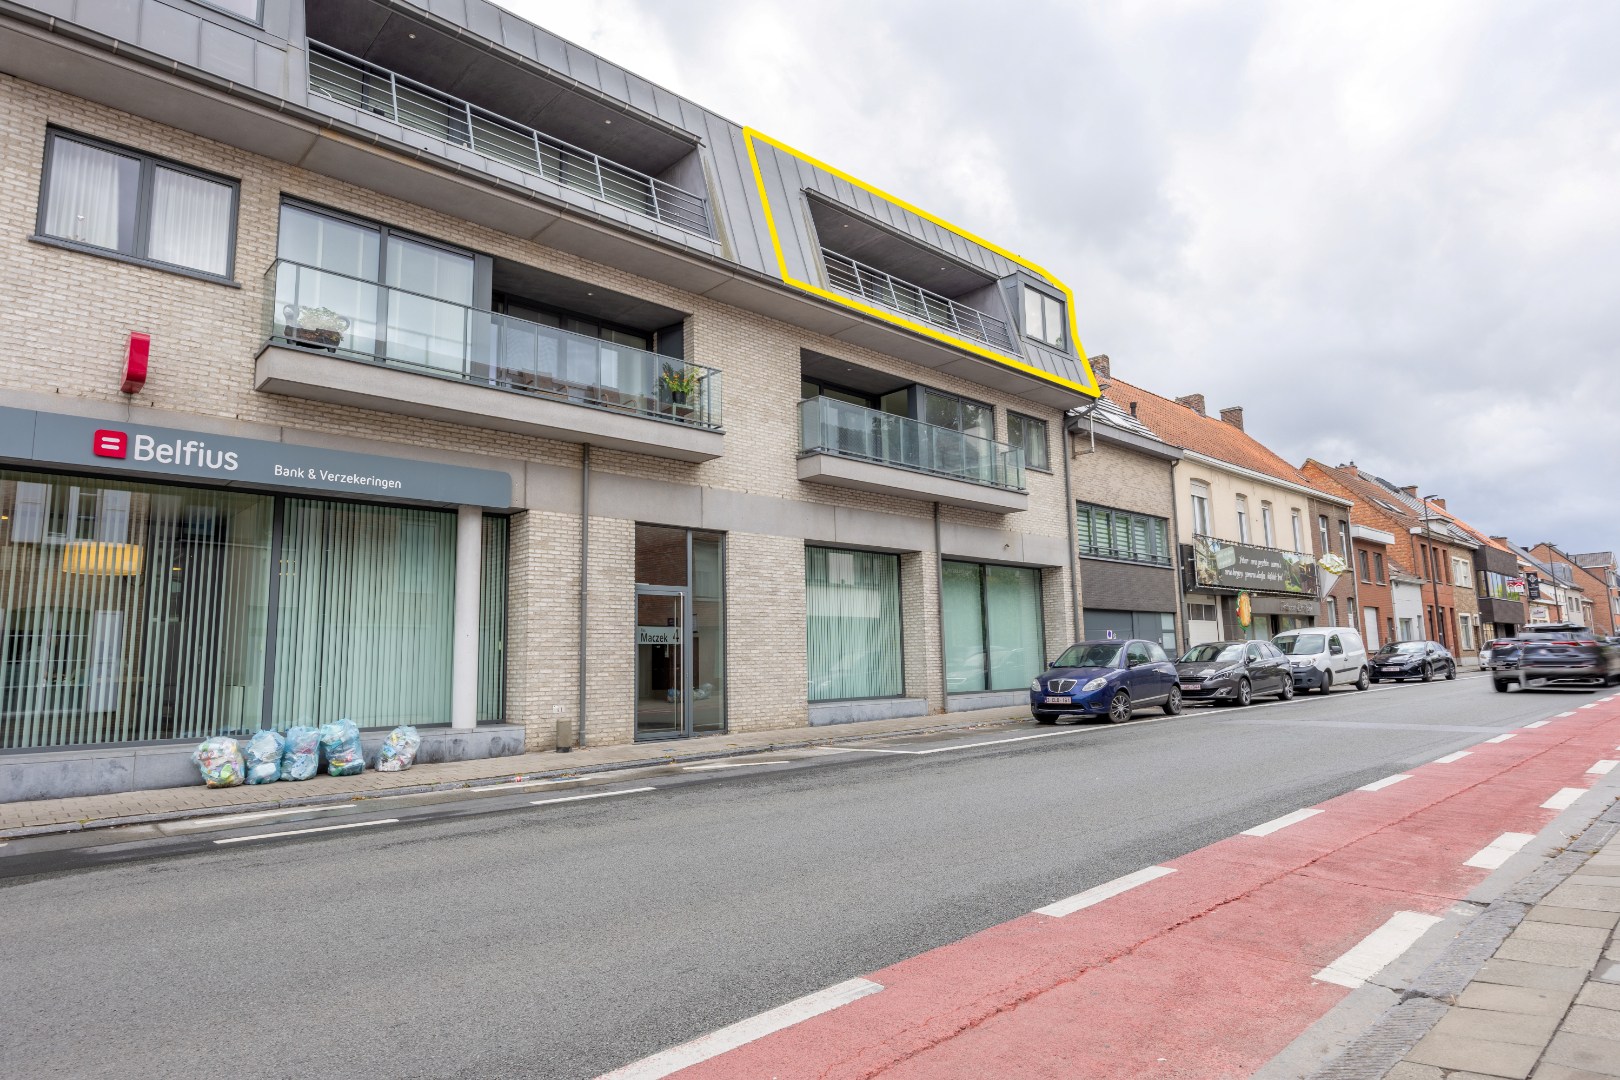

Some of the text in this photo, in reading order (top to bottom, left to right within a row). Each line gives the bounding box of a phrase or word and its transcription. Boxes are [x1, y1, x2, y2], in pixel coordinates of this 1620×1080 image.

[134, 434, 239, 471] Belfius
[274, 464, 402, 490] Bank & Verzekeringen
[640, 628, 679, 643] Maczek 4
